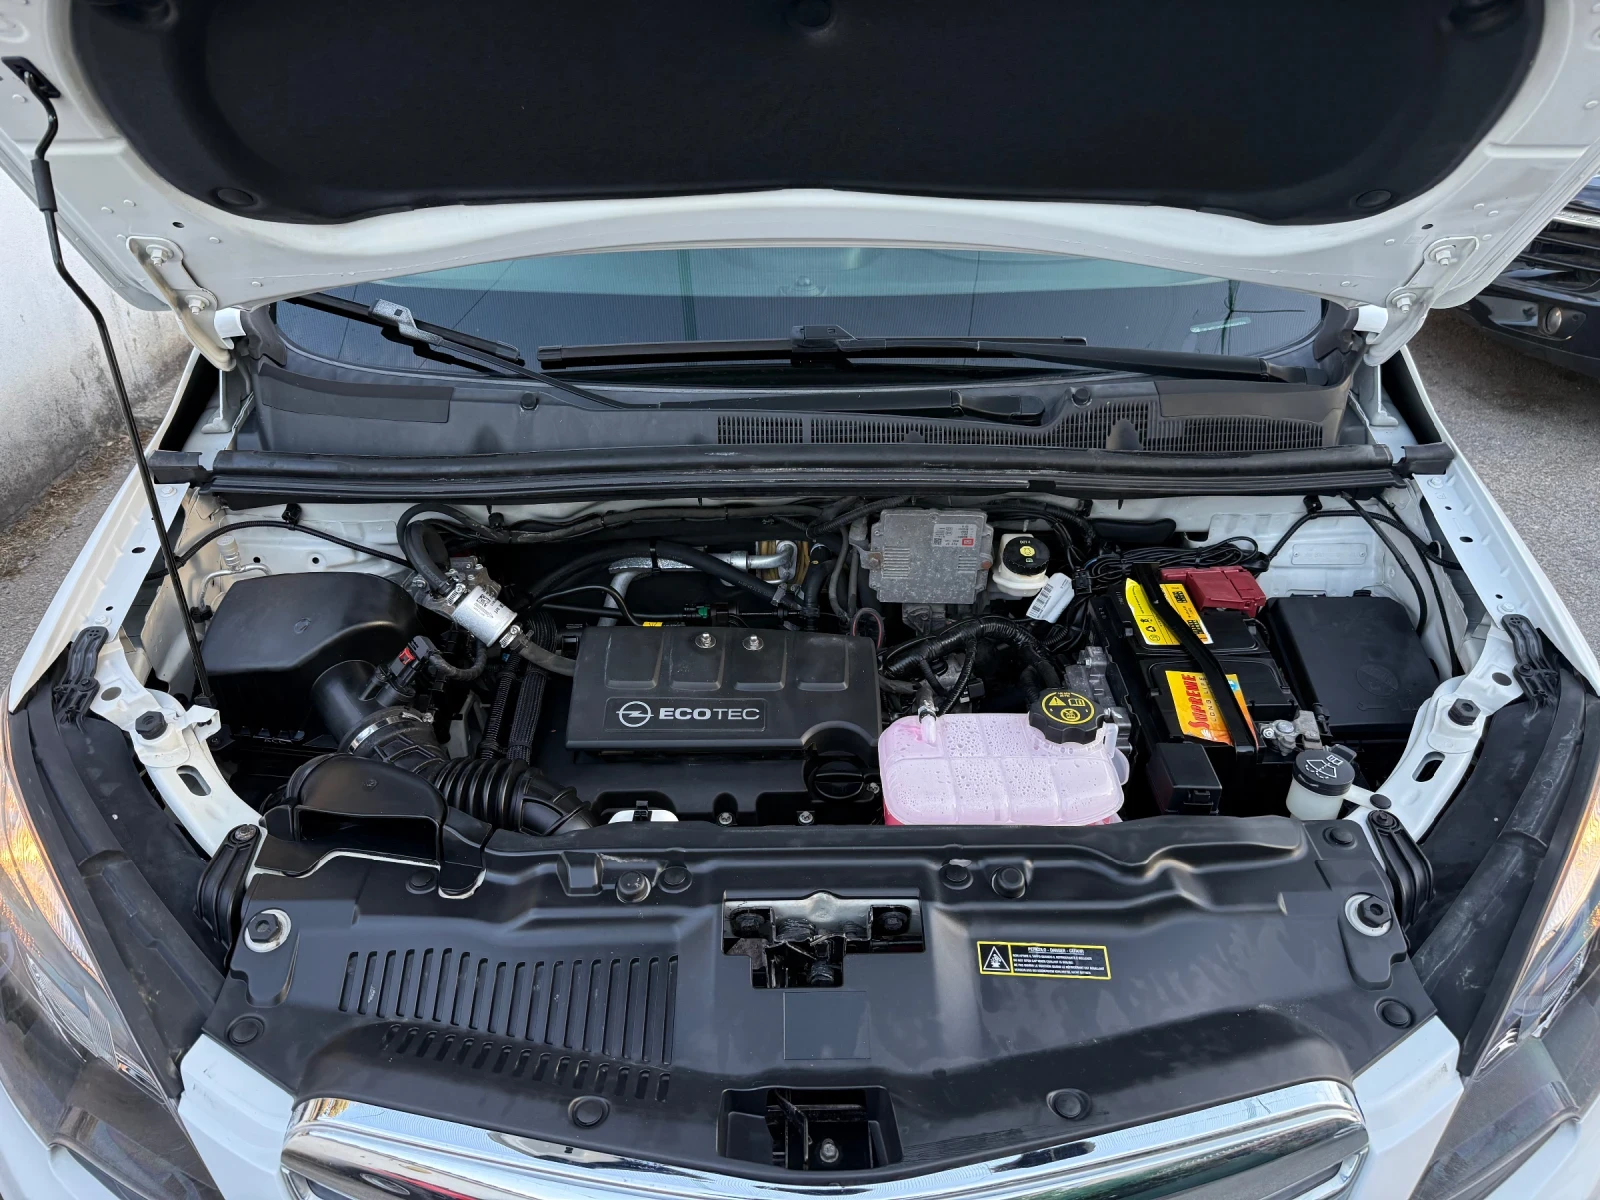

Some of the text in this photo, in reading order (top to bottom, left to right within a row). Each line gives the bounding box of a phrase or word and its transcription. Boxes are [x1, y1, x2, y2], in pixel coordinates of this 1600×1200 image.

[1181, 673, 1210, 730] SUPREME
[1204, 699, 1218, 722] LONG
[658, 707, 760, 720] ECOTEC
